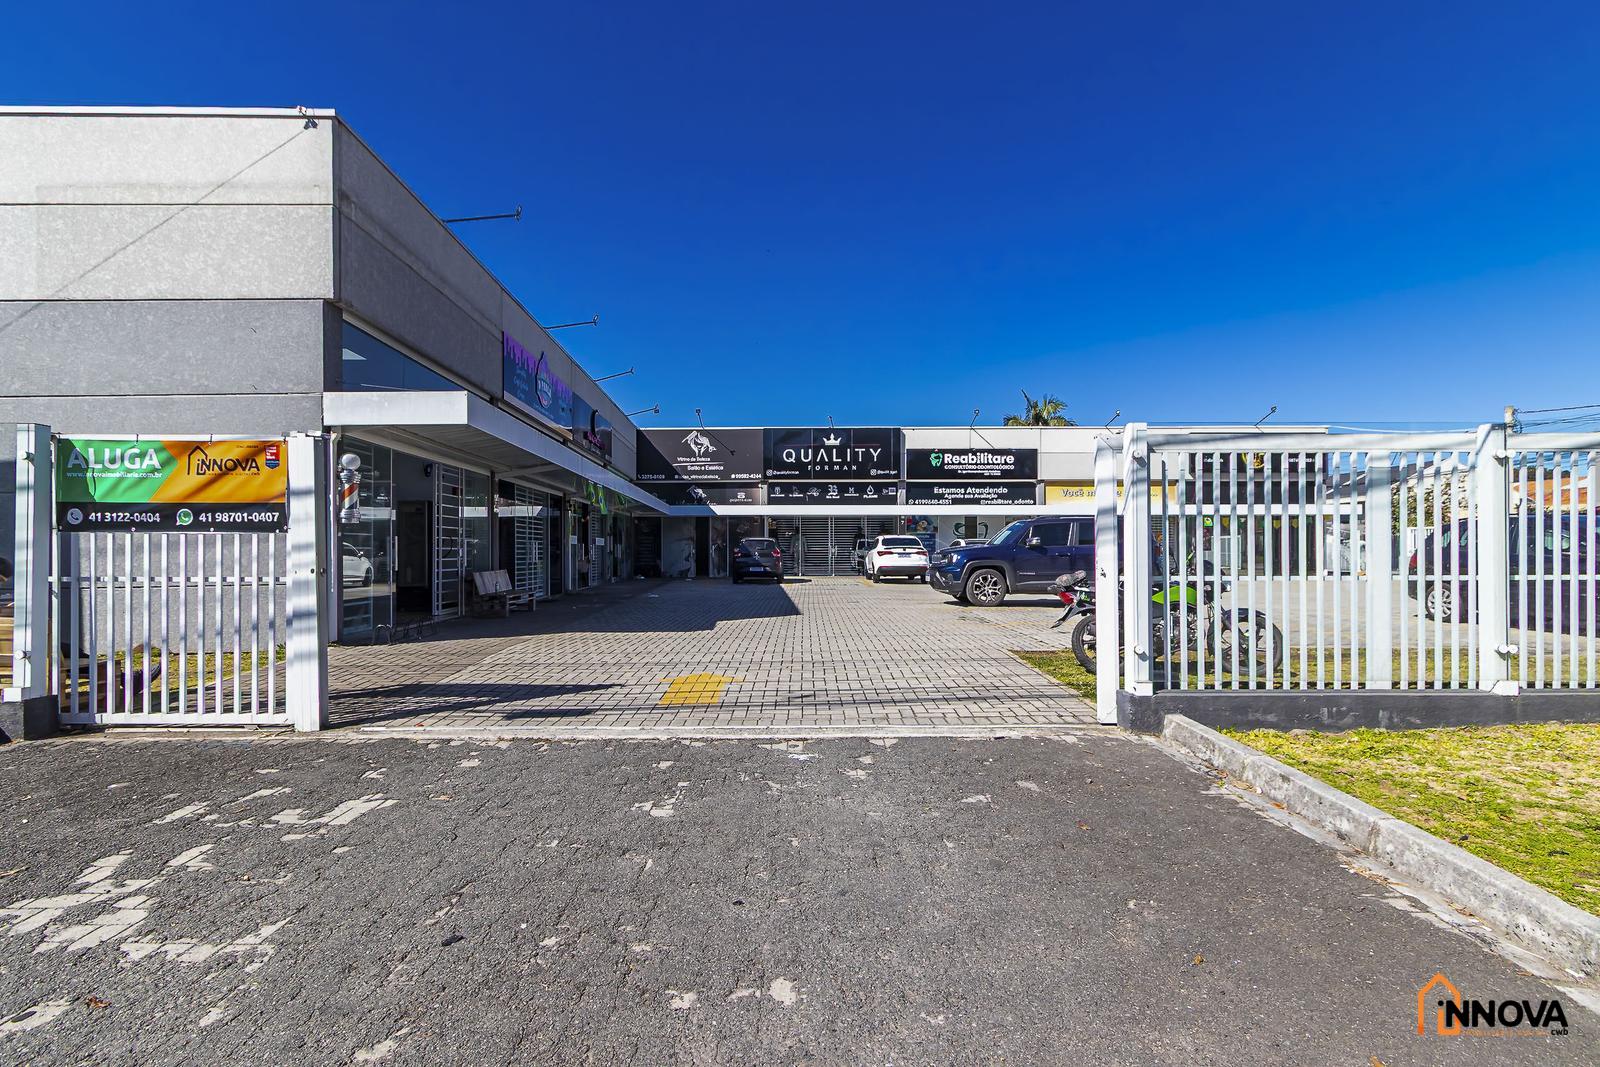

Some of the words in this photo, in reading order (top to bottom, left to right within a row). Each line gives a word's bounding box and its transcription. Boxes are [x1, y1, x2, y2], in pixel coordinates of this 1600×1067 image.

[67, 447, 161, 469] ALUGA
[783, 448, 881, 463] QUALITY
[944, 452, 1015, 464] Reabilitare
[933, 486, 965, 494] Estamos
[966, 486, 1008, 494] Atendendo
[1062, 488, 1084, 497] Você
[89, 512, 102, 522] 41
[104, 512, 161, 522] 3122-0404
[199, 512, 212, 522] 41
[215, 512, 280, 522] 98701-0407
